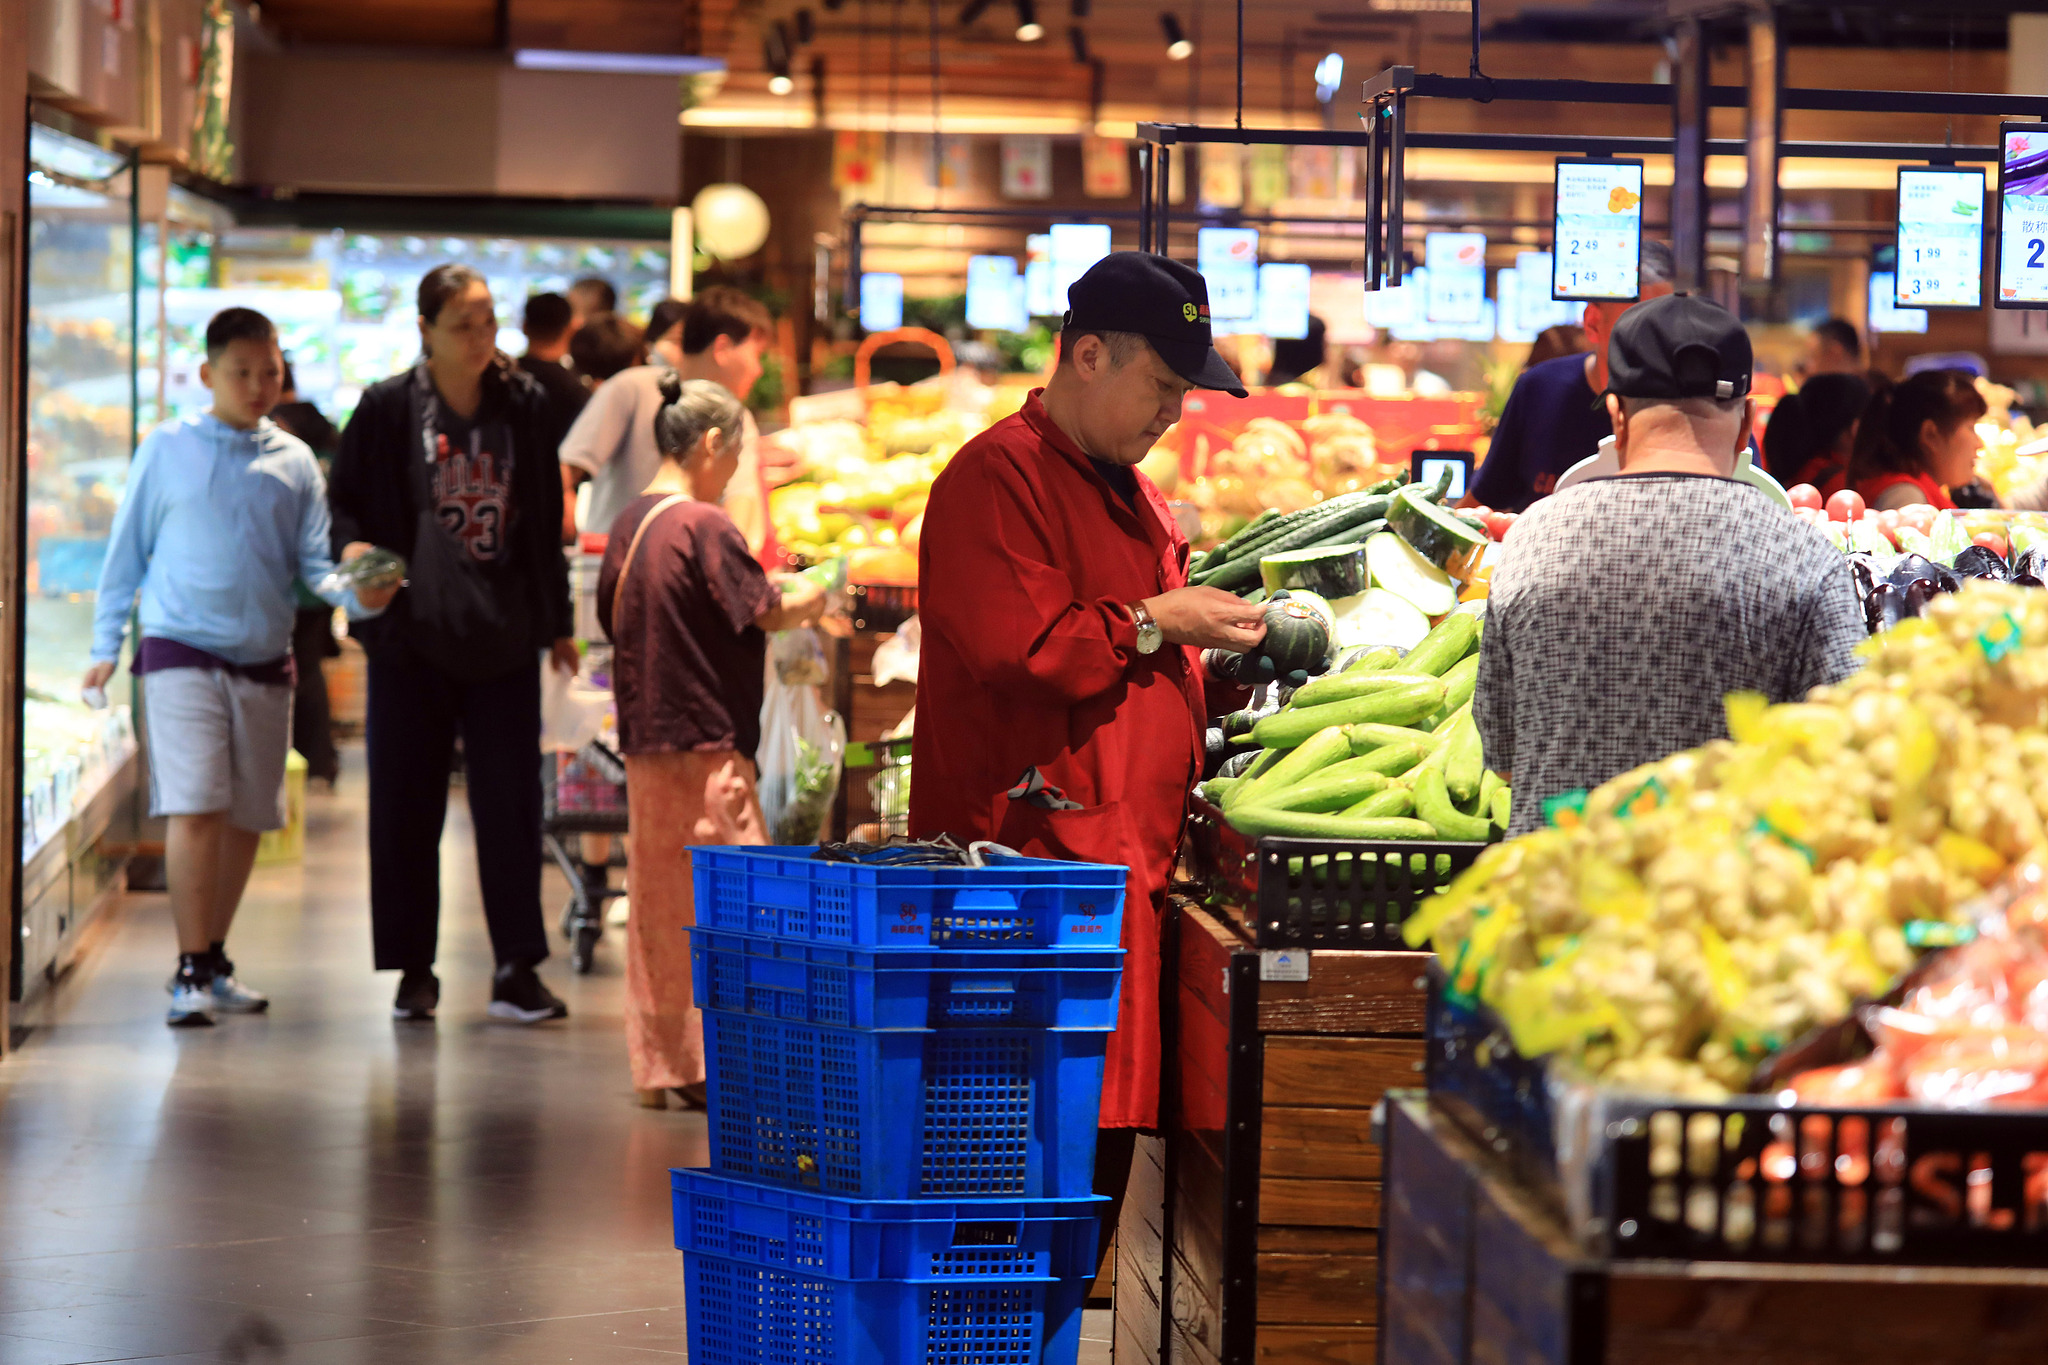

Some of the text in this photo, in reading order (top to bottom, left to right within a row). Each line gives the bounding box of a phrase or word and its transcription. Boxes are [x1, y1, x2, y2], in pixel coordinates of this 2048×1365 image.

[2027, 239, 2045, 268] 2
[1185, 305, 1195, 316] SL
[439, 499, 505, 561] 23
